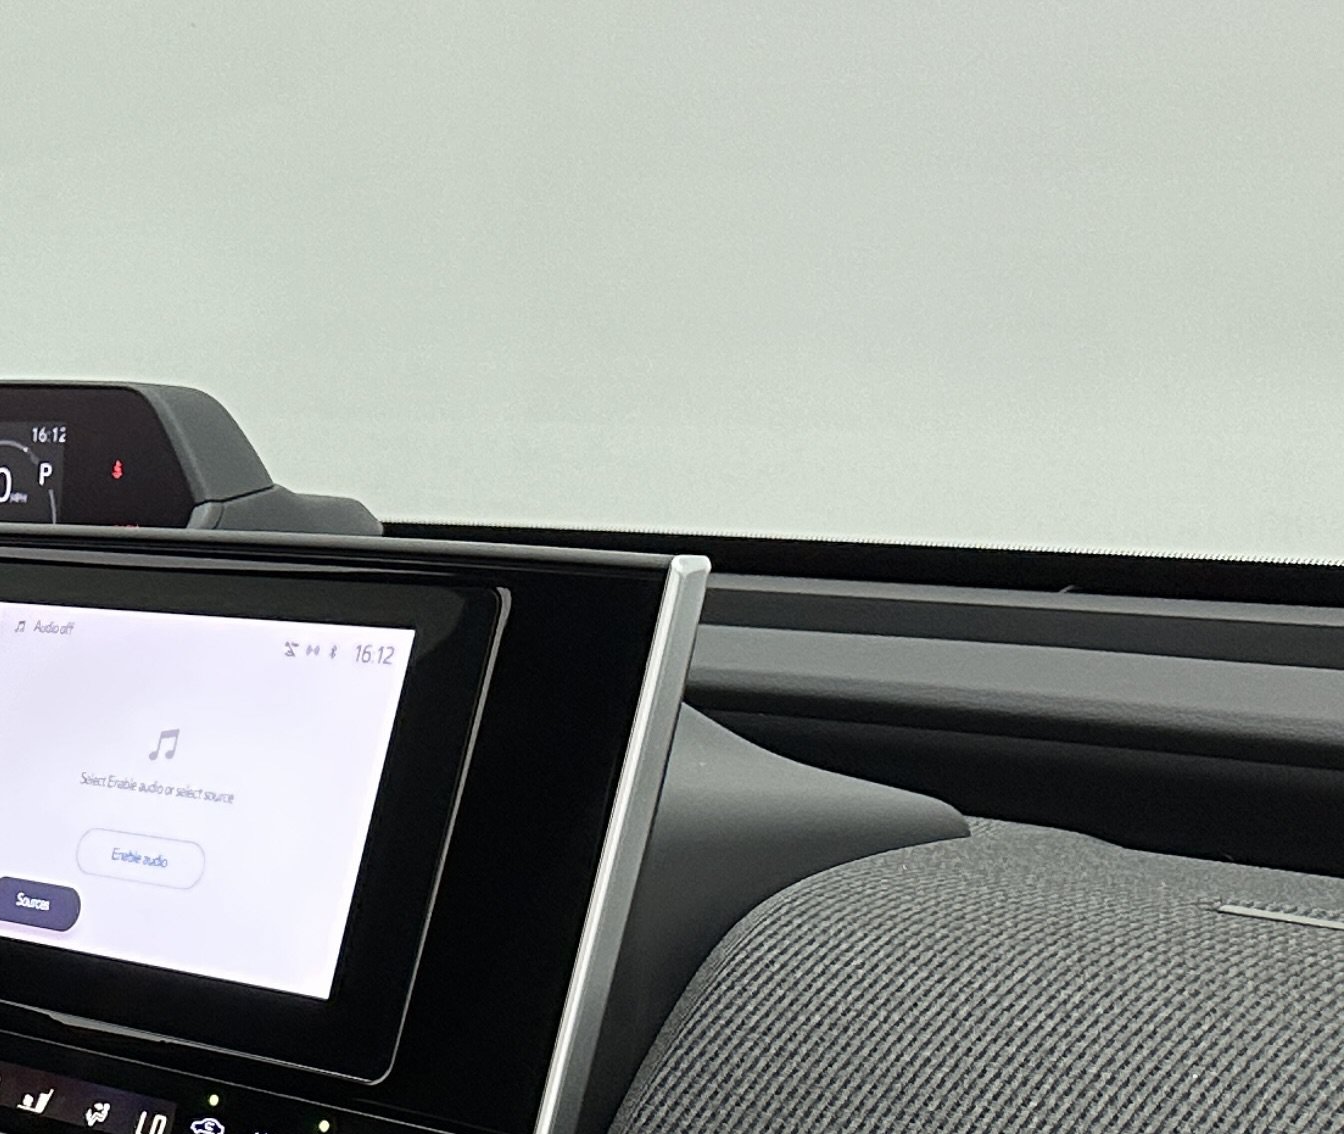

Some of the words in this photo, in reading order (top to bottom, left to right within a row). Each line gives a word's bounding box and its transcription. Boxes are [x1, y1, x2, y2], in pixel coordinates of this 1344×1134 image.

[32, 426, 66, 443] 16:12
[38, 462, 53, 486] P
[355, 644, 395, 665] 16:12
[16, 891, 50, 911] Sources
